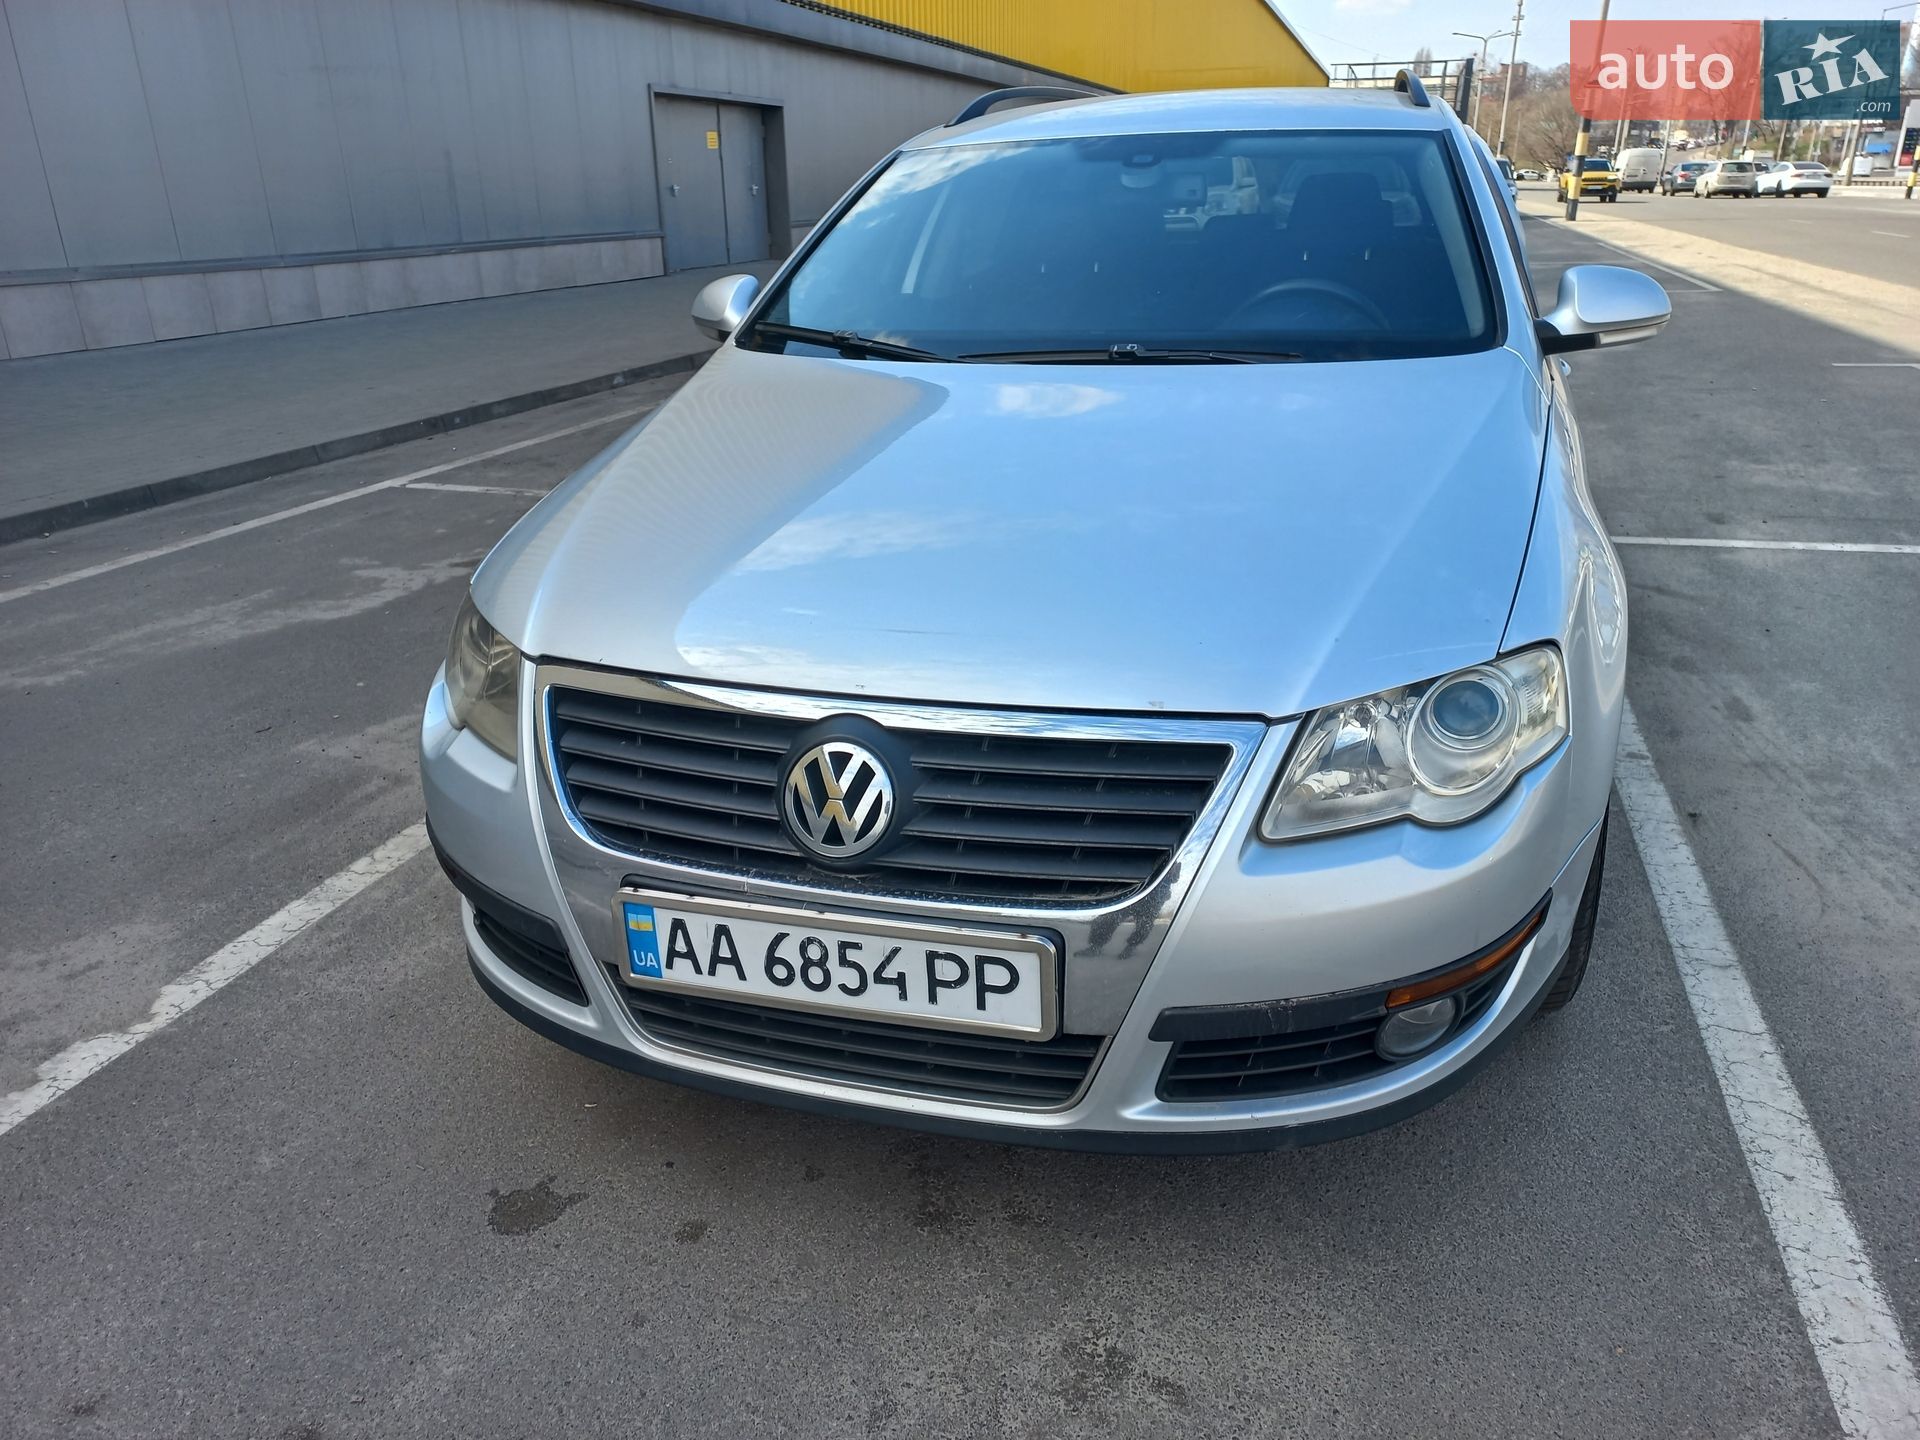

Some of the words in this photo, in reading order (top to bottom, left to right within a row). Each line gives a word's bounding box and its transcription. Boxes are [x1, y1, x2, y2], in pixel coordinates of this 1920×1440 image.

[633, 949, 659, 969] UA
[664, 917, 747, 982] AA
[763, 932, 909, 1002] 6854
[925, 949, 1021, 1011] PP
